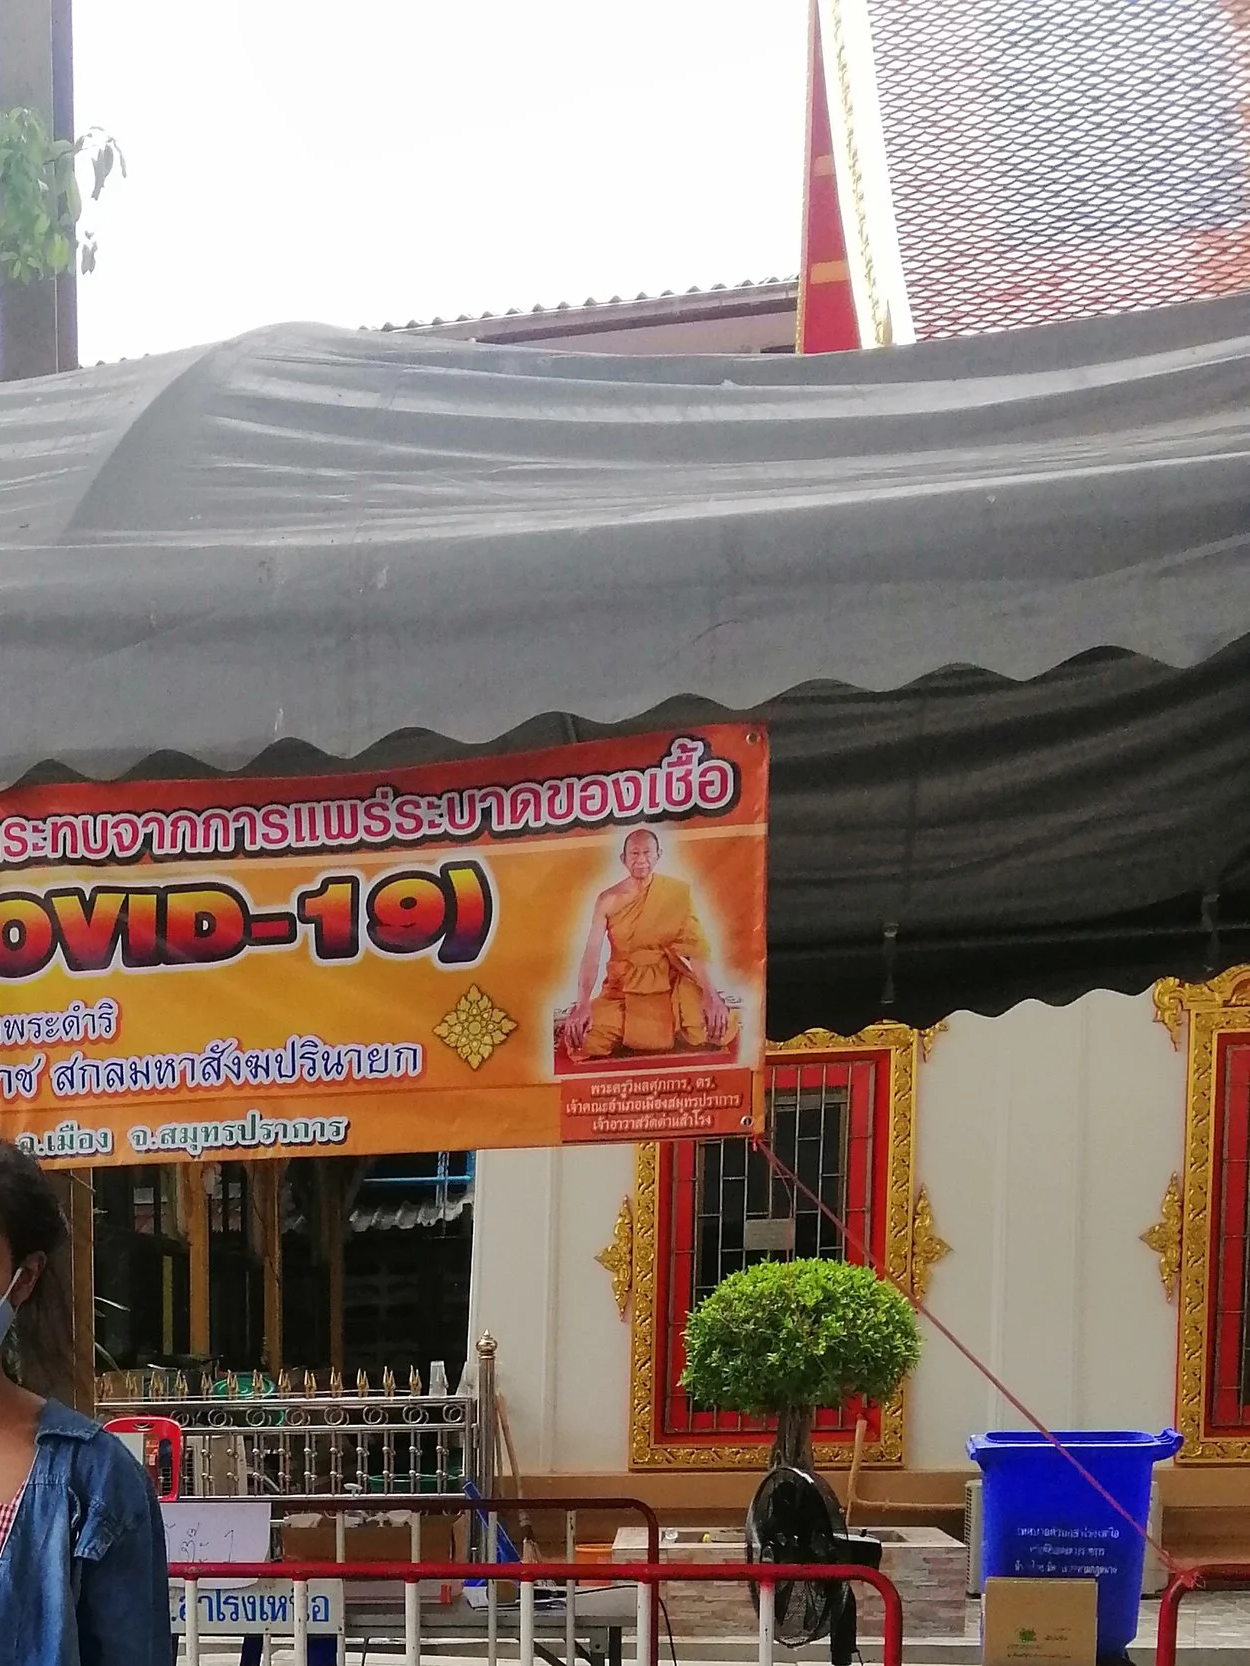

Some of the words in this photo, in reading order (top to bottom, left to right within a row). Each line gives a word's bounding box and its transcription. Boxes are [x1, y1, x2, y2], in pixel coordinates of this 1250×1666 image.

[53, 1037, 422, 1093] สกลมหาสังฆปรินายก
[131, 1115, 347, 1156] จ.สมุทรปราการ
